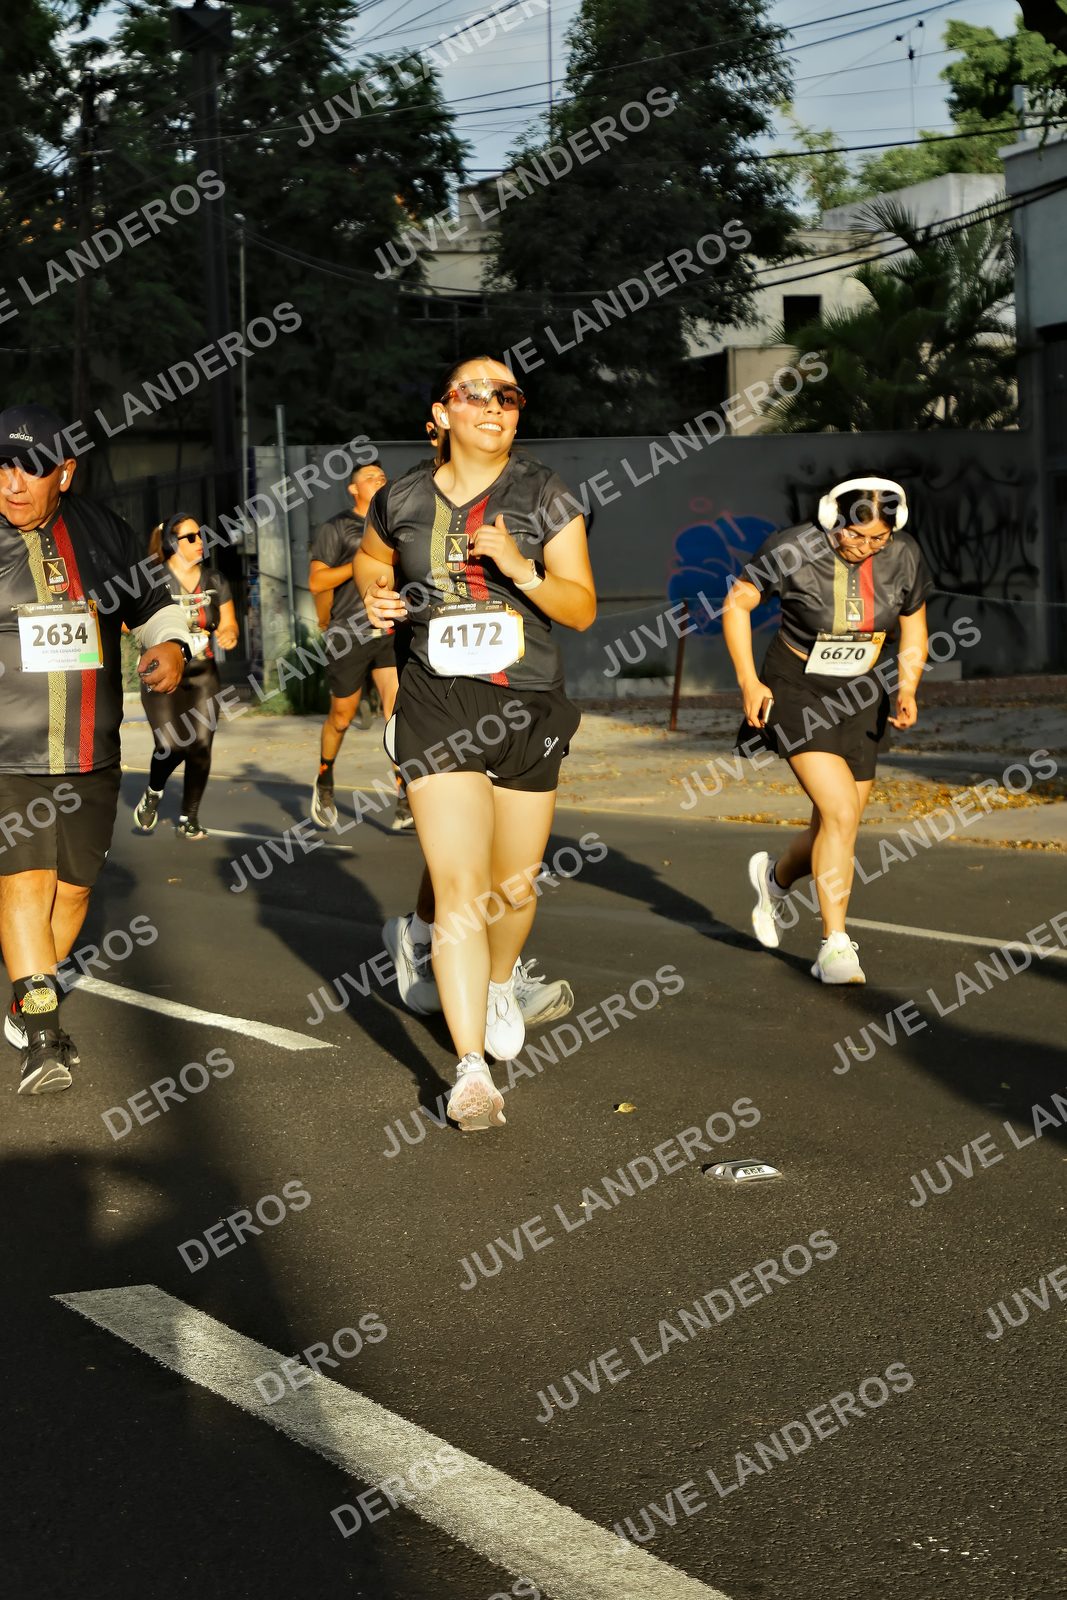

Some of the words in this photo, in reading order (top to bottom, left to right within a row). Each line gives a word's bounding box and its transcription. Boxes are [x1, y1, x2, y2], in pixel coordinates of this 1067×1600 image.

[9, 432, 34, 442] adidas
[31, 622, 88, 646] 2634
[440, 621, 503, 648] 4172
[820, 647, 866, 660] 6670
